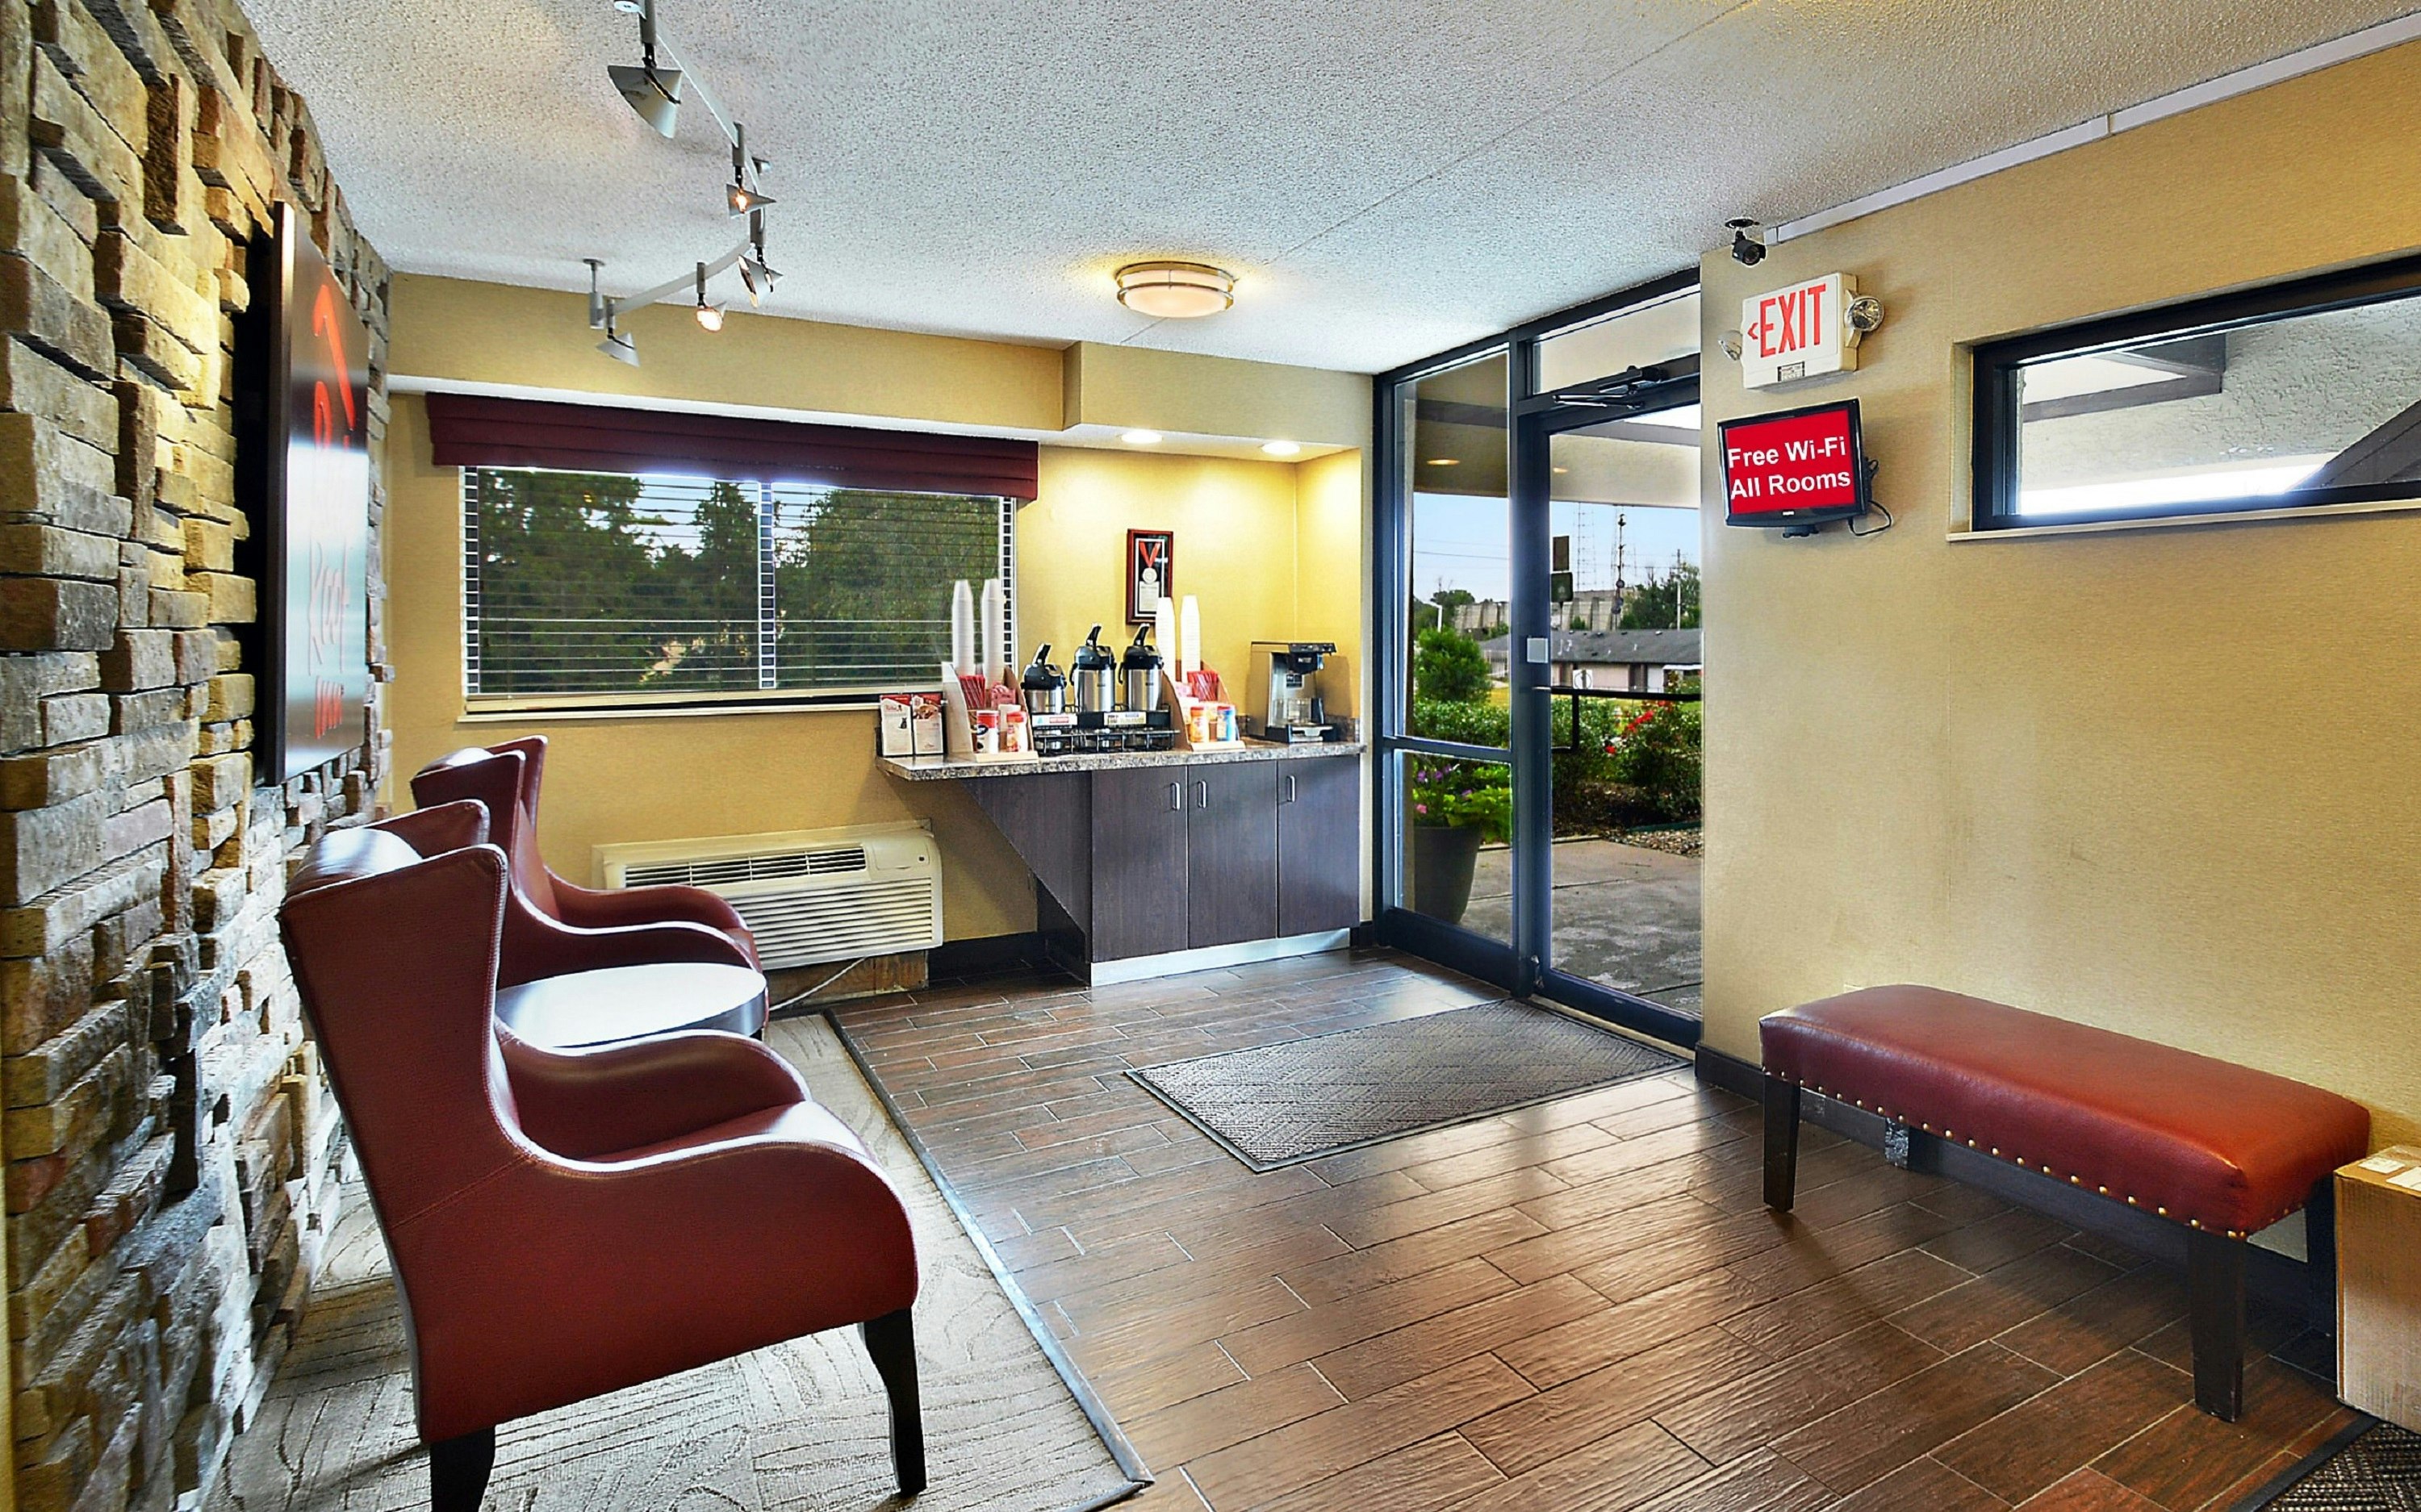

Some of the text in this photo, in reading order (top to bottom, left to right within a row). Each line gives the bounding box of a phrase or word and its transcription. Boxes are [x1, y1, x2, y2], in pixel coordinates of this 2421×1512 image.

[1760, 283, 1826, 358] EXIT
[1728, 436, 1846, 468] Free Wi-Fi
[1729, 470, 1851, 499] All Rooms
